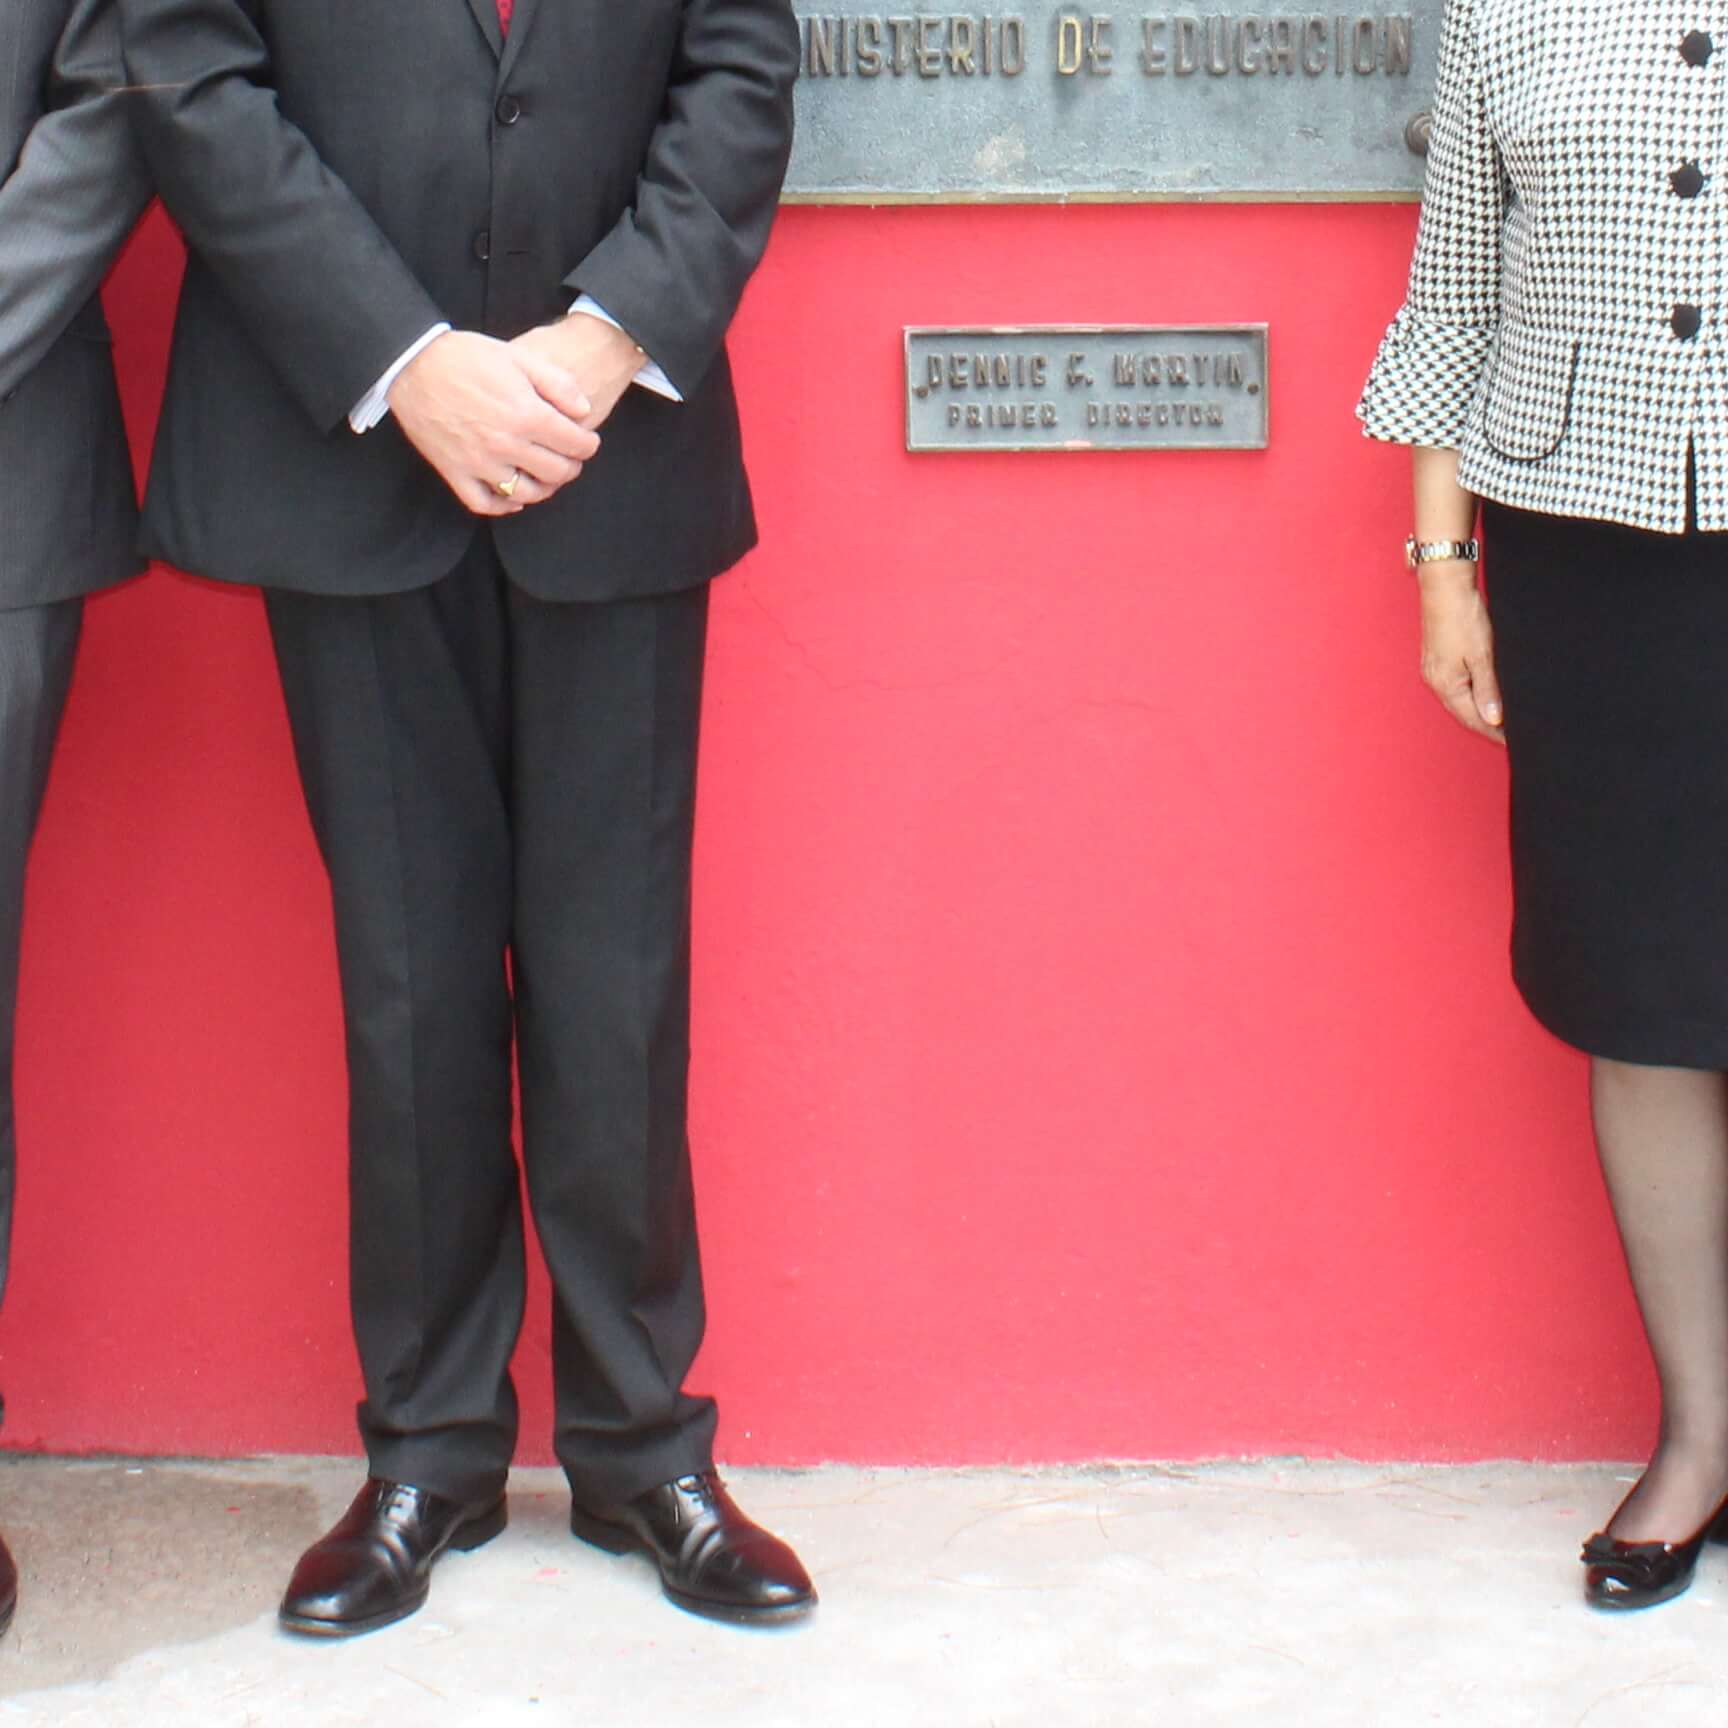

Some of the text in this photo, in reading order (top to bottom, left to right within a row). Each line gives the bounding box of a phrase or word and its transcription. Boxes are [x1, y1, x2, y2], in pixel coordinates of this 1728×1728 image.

[805, 13, 1412, 78] NISTERIO DE EDUCACION
[926, 352, 1047, 388] DENNIS
[947, 401, 1224, 427] PRIMER DIRECTOR
